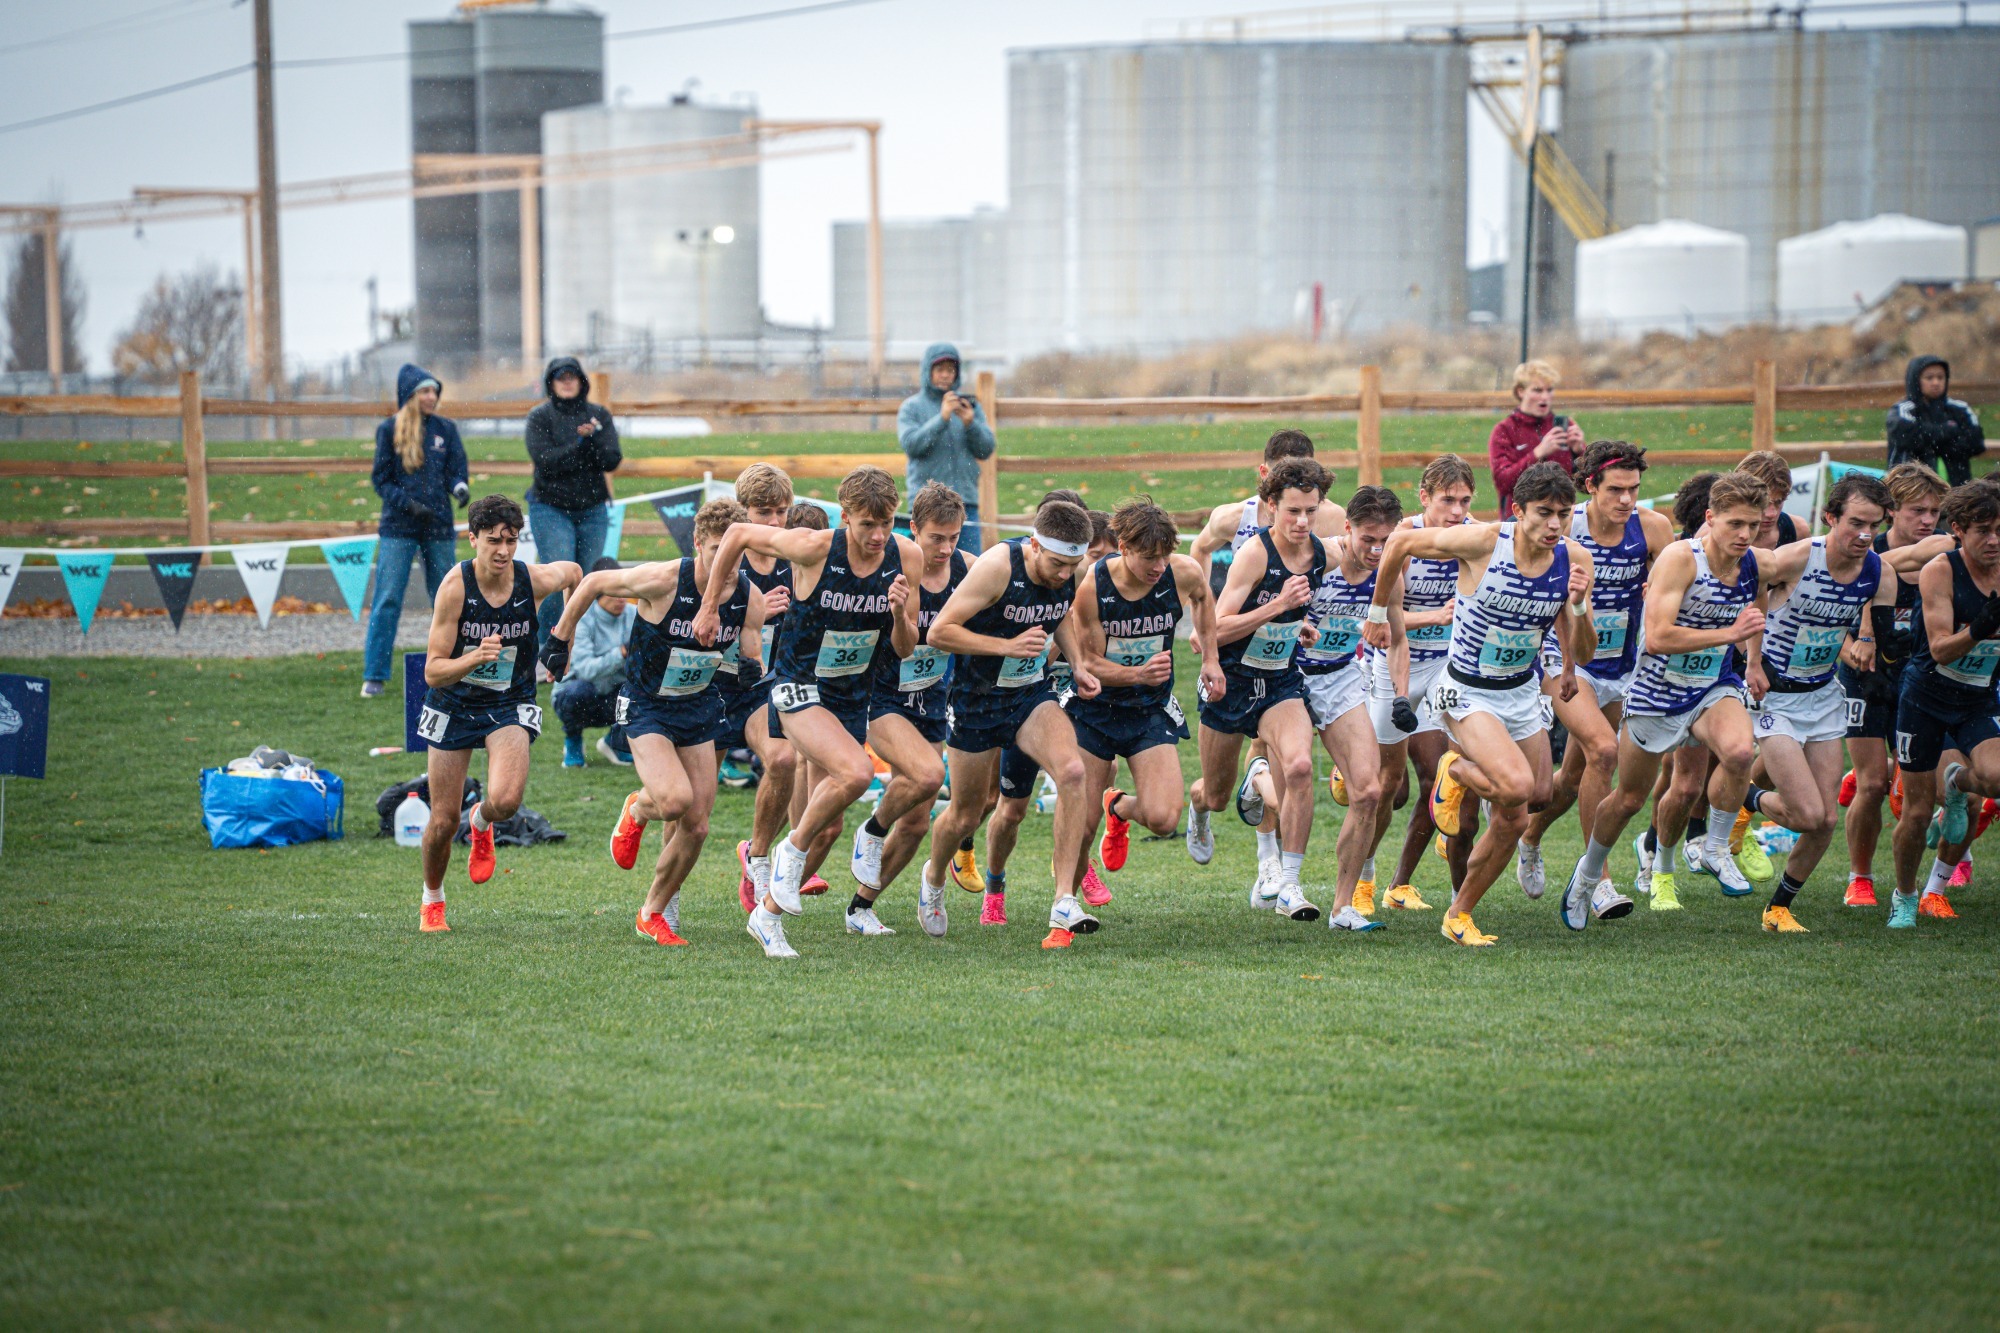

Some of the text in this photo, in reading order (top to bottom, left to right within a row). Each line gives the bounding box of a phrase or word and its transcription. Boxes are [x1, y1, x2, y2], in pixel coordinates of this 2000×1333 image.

[662, 502, 697, 518] WCC
[245, 558, 278, 572] WCC
[333, 552, 367, 565] WCC
[67, 564, 101, 577] WCC
[157, 563, 192, 578] WCC
[831, 566, 845, 574] WCC
[1408, 579, 1457, 595] PORTLA
[680, 596, 694, 604] WCC
[1483, 591, 1564, 617] PORTLAND
[1003, 600, 1069, 624] GONZAGA
[1313, 602, 1370, 618] PORTLAN
[1798, 598, 1861, 619] PORTLAN
[461, 621, 530, 639] GONZAGA
[669, 619, 741, 642] GOAGA
[1102, 612, 1174, 637] GONZAGA
[1266, 625, 1298, 639] WCC
[832, 633, 872, 647] WCC
[1323, 632, 1350, 647] 132
[1495, 630, 1535, 647] WCC
[1806, 629, 1841, 644] WCC
[1117, 640, 1156, 653] WCC
[1262, 641, 1286, 655] 30
[1804, 646, 1832, 662] 133
[679, 653, 716, 668] WCC
[835, 650, 858, 662] 36
[1121, 655, 1145, 667] 32
[1495, 647, 1526, 662] 139
[914, 658, 935, 674] 39
[1016, 658, 1035, 672] 25
[1682, 654, 1712, 671] 130
[1958, 656, 1985, 670] 114
[679, 669, 702, 682] 38
[781, 683, 809, 706] 36
[418, 709, 439, 737] 24
